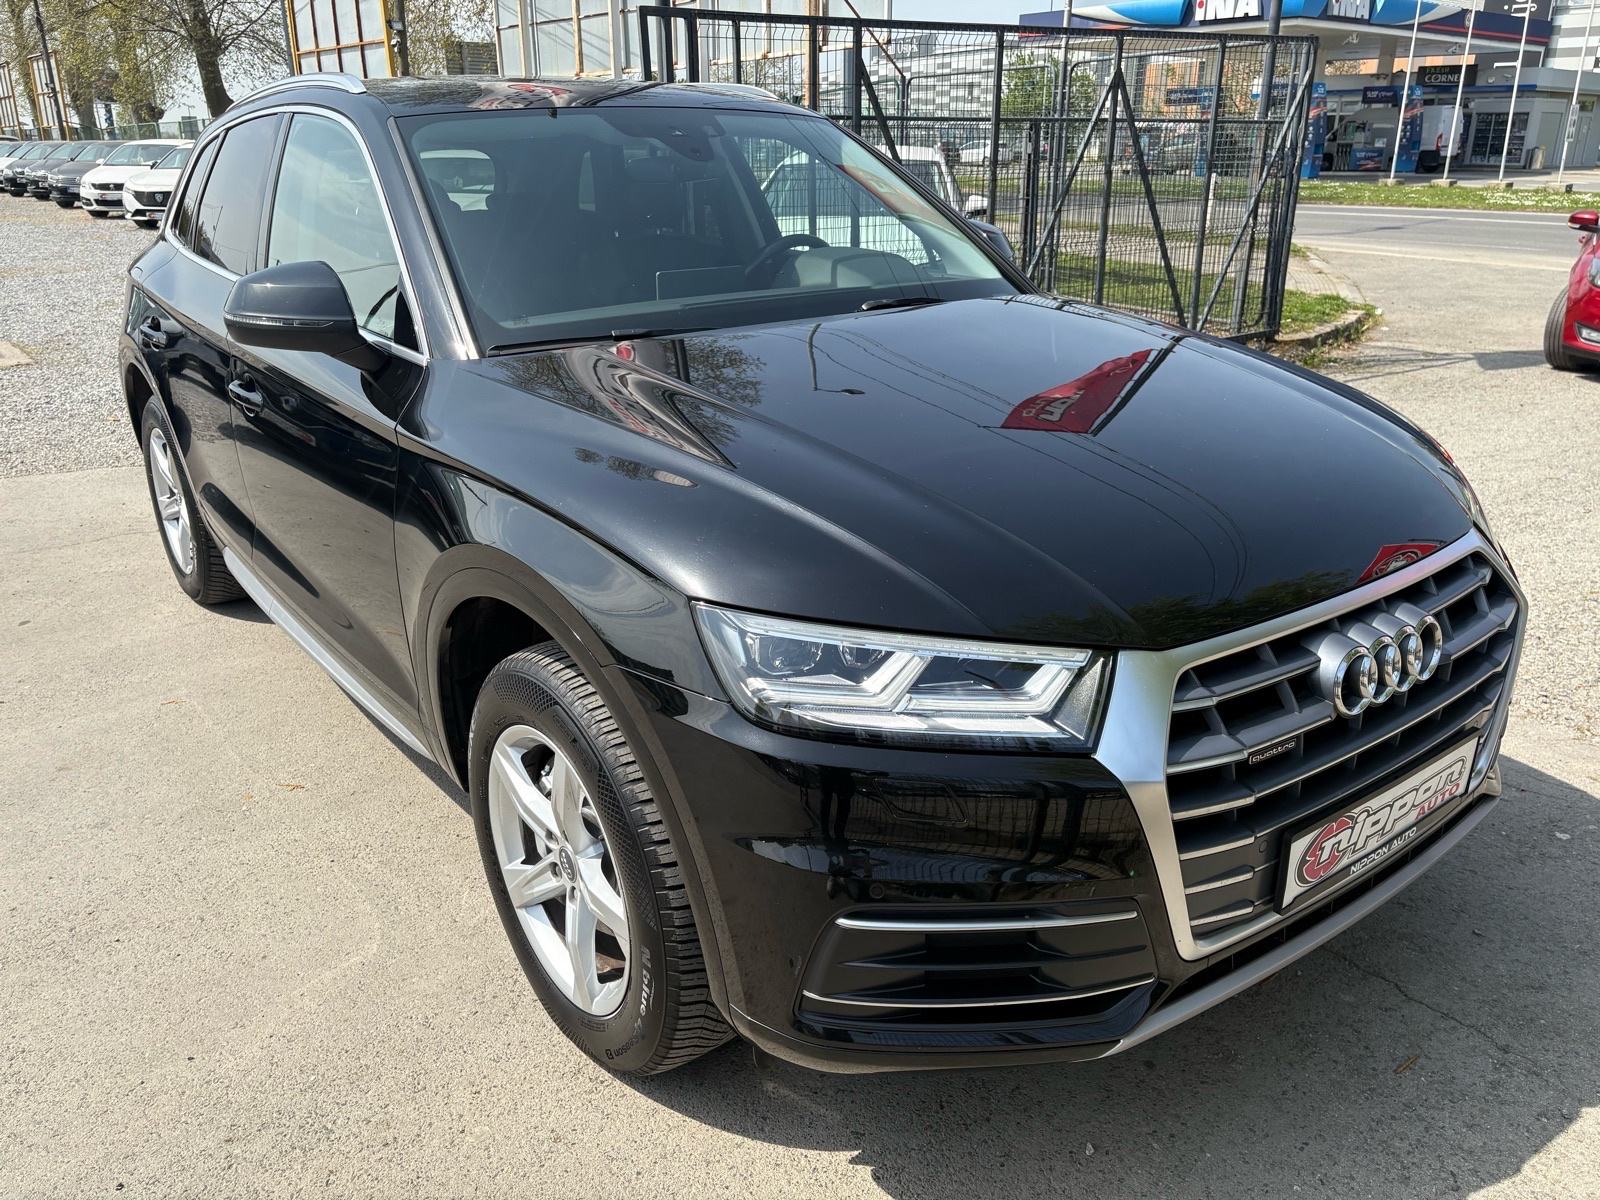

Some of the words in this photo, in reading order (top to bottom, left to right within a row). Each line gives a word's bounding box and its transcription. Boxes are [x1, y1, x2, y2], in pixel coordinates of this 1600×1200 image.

[1424, 73, 1465, 83] CORNE
[1252, 741, 1295, 763] quattro
[1415, 783, 1460, 820] AUTO
[1350, 844, 1389, 874] NIPPON
[1390, 826, 1417, 850] AUTO
